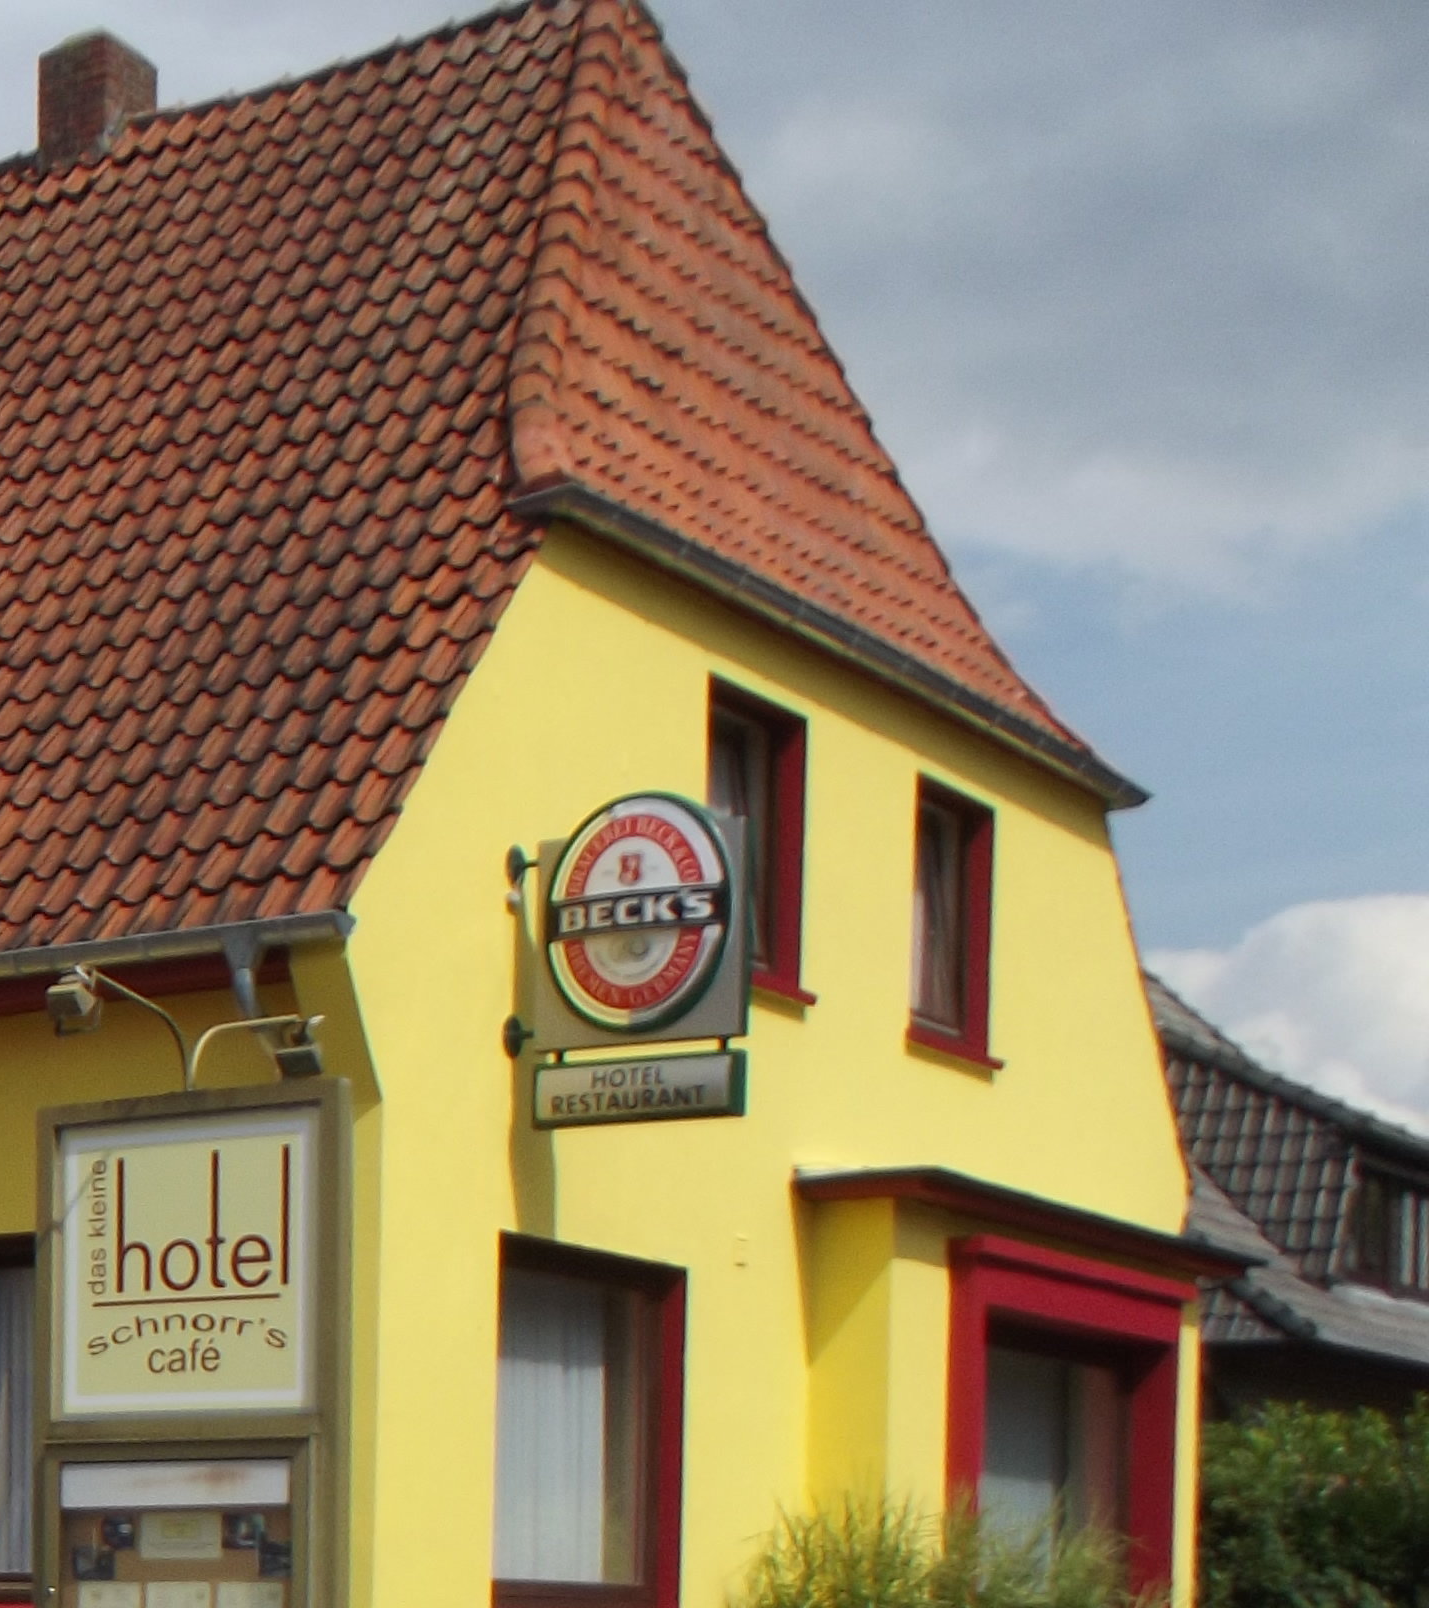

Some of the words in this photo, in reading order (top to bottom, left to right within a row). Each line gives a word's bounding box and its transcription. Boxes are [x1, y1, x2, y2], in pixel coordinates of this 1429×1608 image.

[559, 890, 713, 933] BECK'S
[550, 1084, 705, 1115] RESTAURANT
[591, 1066, 665, 1090] HOTEL
[86, 1159, 108, 1238] kleine
[115, 1144, 290, 1294] hotel
[86, 1247, 108, 1296] das
[87, 1312, 288, 1356] schnorr's
[147, 1338, 222, 1375] café
